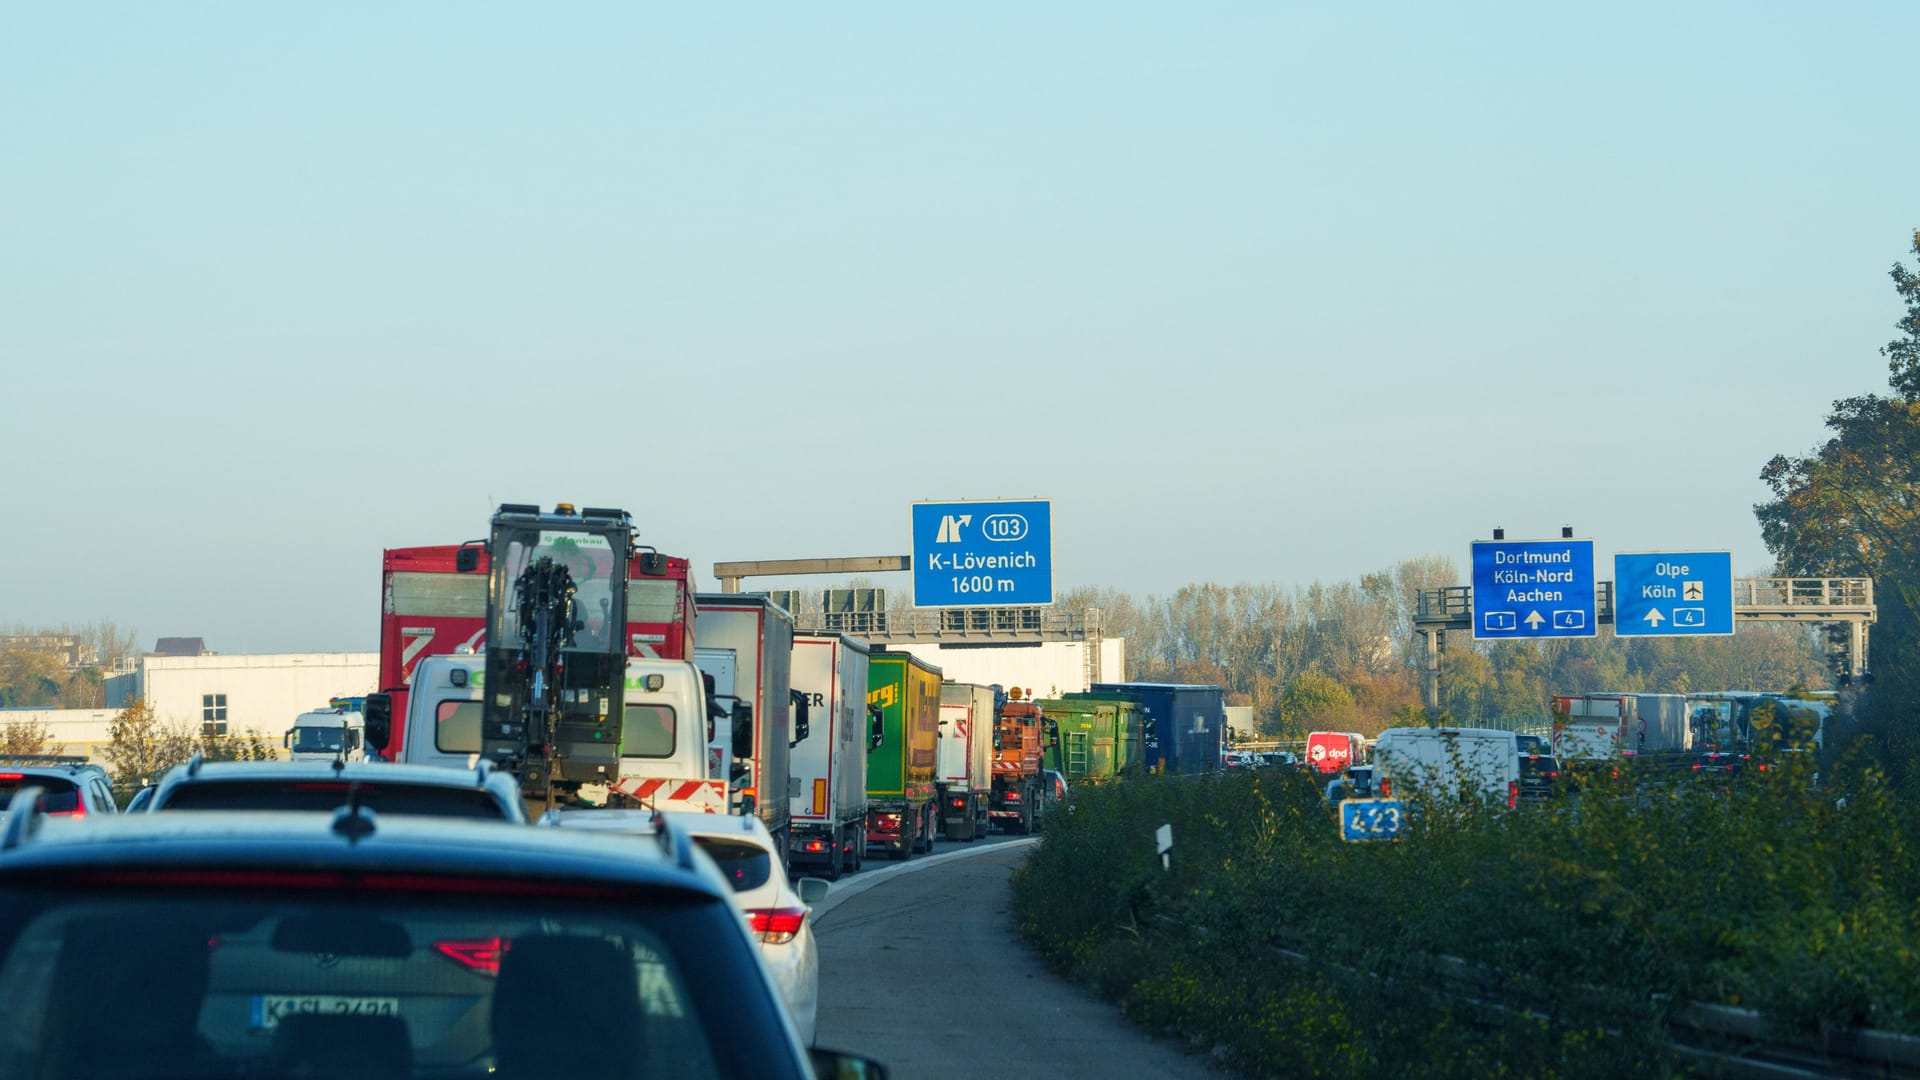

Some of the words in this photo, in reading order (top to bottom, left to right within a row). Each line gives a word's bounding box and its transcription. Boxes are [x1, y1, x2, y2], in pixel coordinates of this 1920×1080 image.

[990, 518, 1020, 536] 103
[928, 551, 1036, 570] K-Lövenich
[1495, 549, 1571, 564] Dortmund
[1494, 569, 1573, 584] Köln-Nord
[1655, 562, 1689, 579] Olpe
[951, 575, 993, 593] 1600
[997, 579, 1015, 592] m
[1642, 584, 1677, 599] Köln
[1506, 588, 1563, 602] Aachen
[1565, 613, 1573, 625] 4
[1684, 611, 1694, 623] 4
[1329, 748, 1347, 759] dpd
